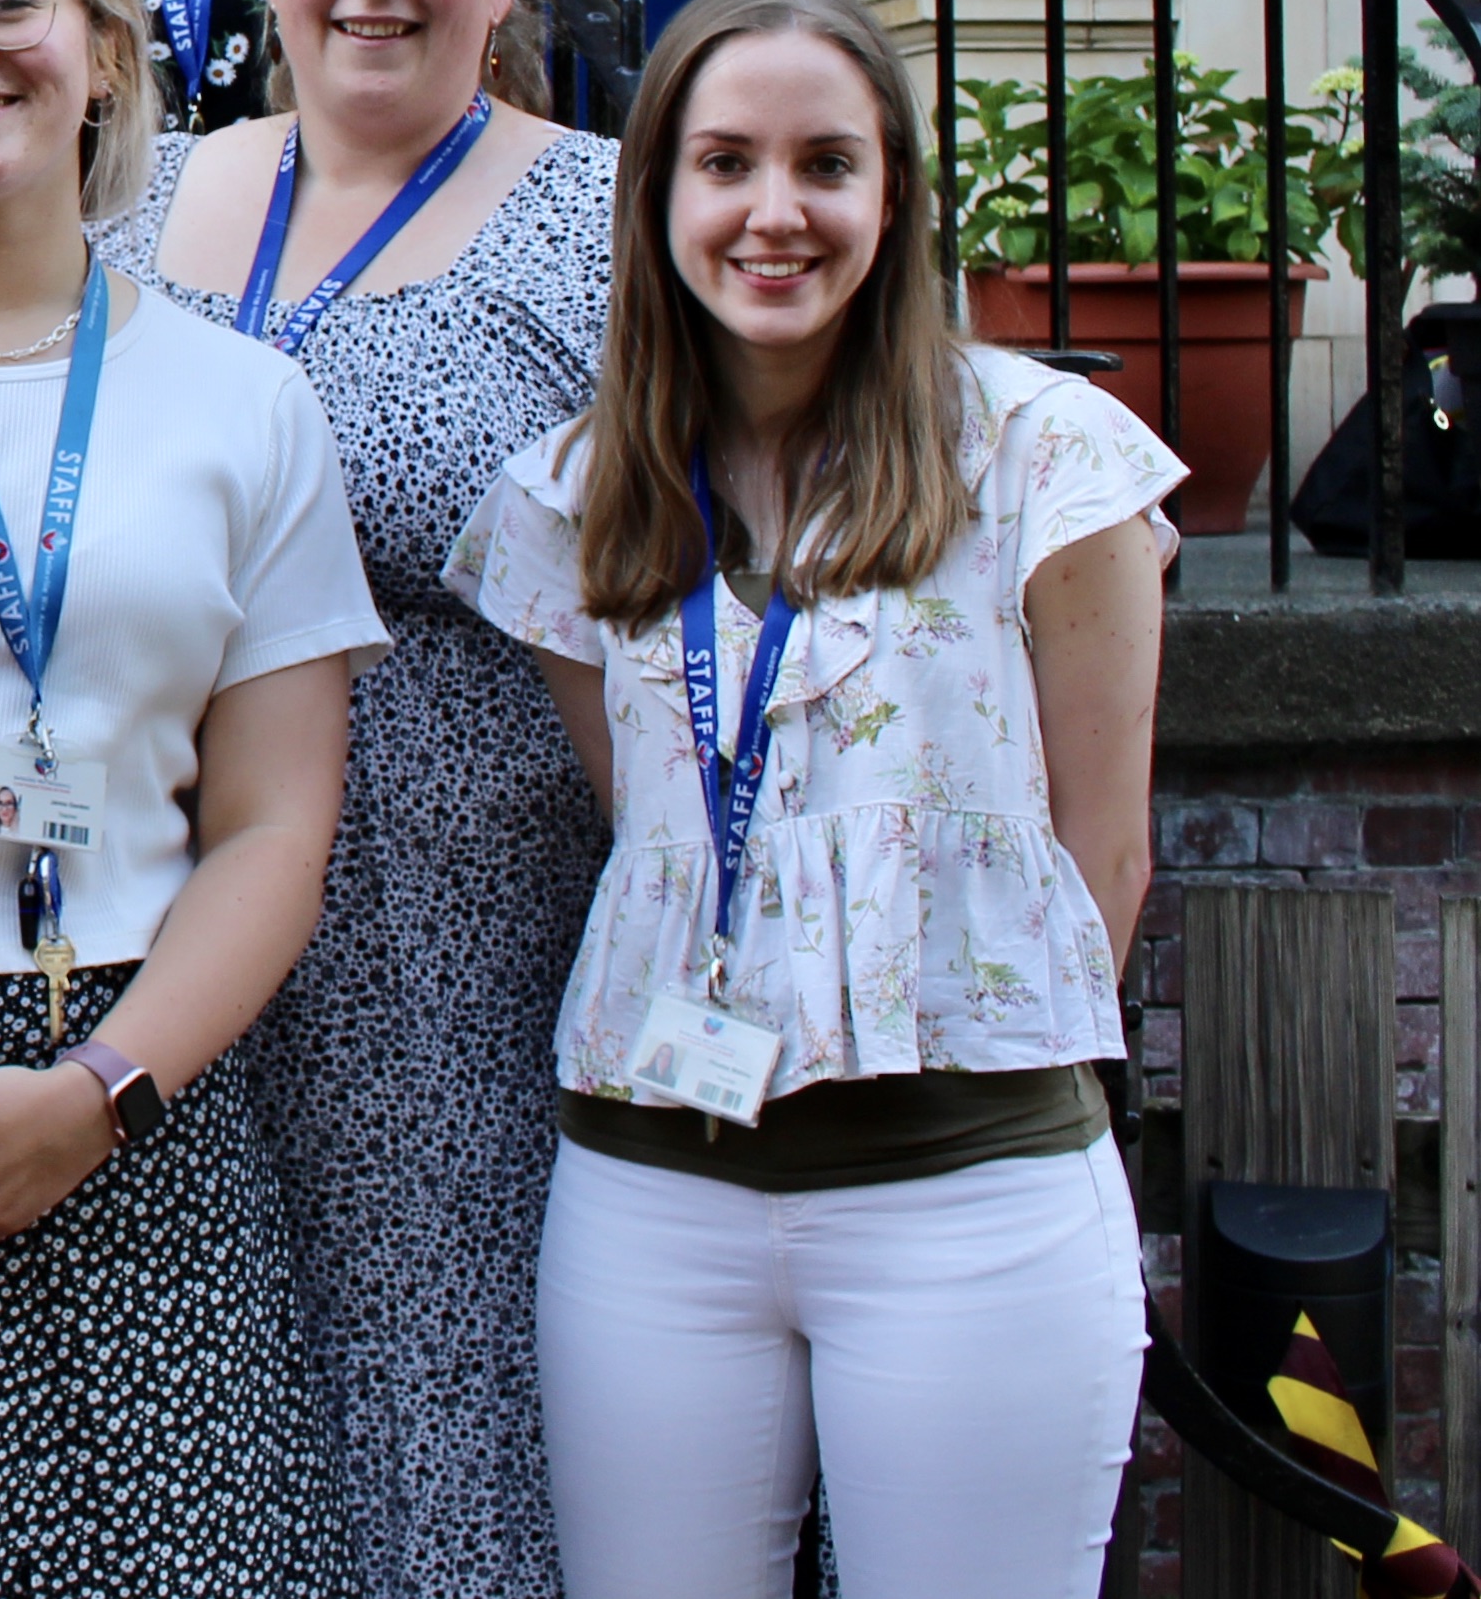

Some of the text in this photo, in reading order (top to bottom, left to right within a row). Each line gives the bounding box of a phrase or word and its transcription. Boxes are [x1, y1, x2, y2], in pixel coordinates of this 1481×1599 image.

[278, 125, 298, 174] STA
[285, 273, 343, 337] STAFF
[46, 449, 81, 525] STAFF
[684, 647, 714, 736] STAFF
[724, 781, 756, 871] STAFF
